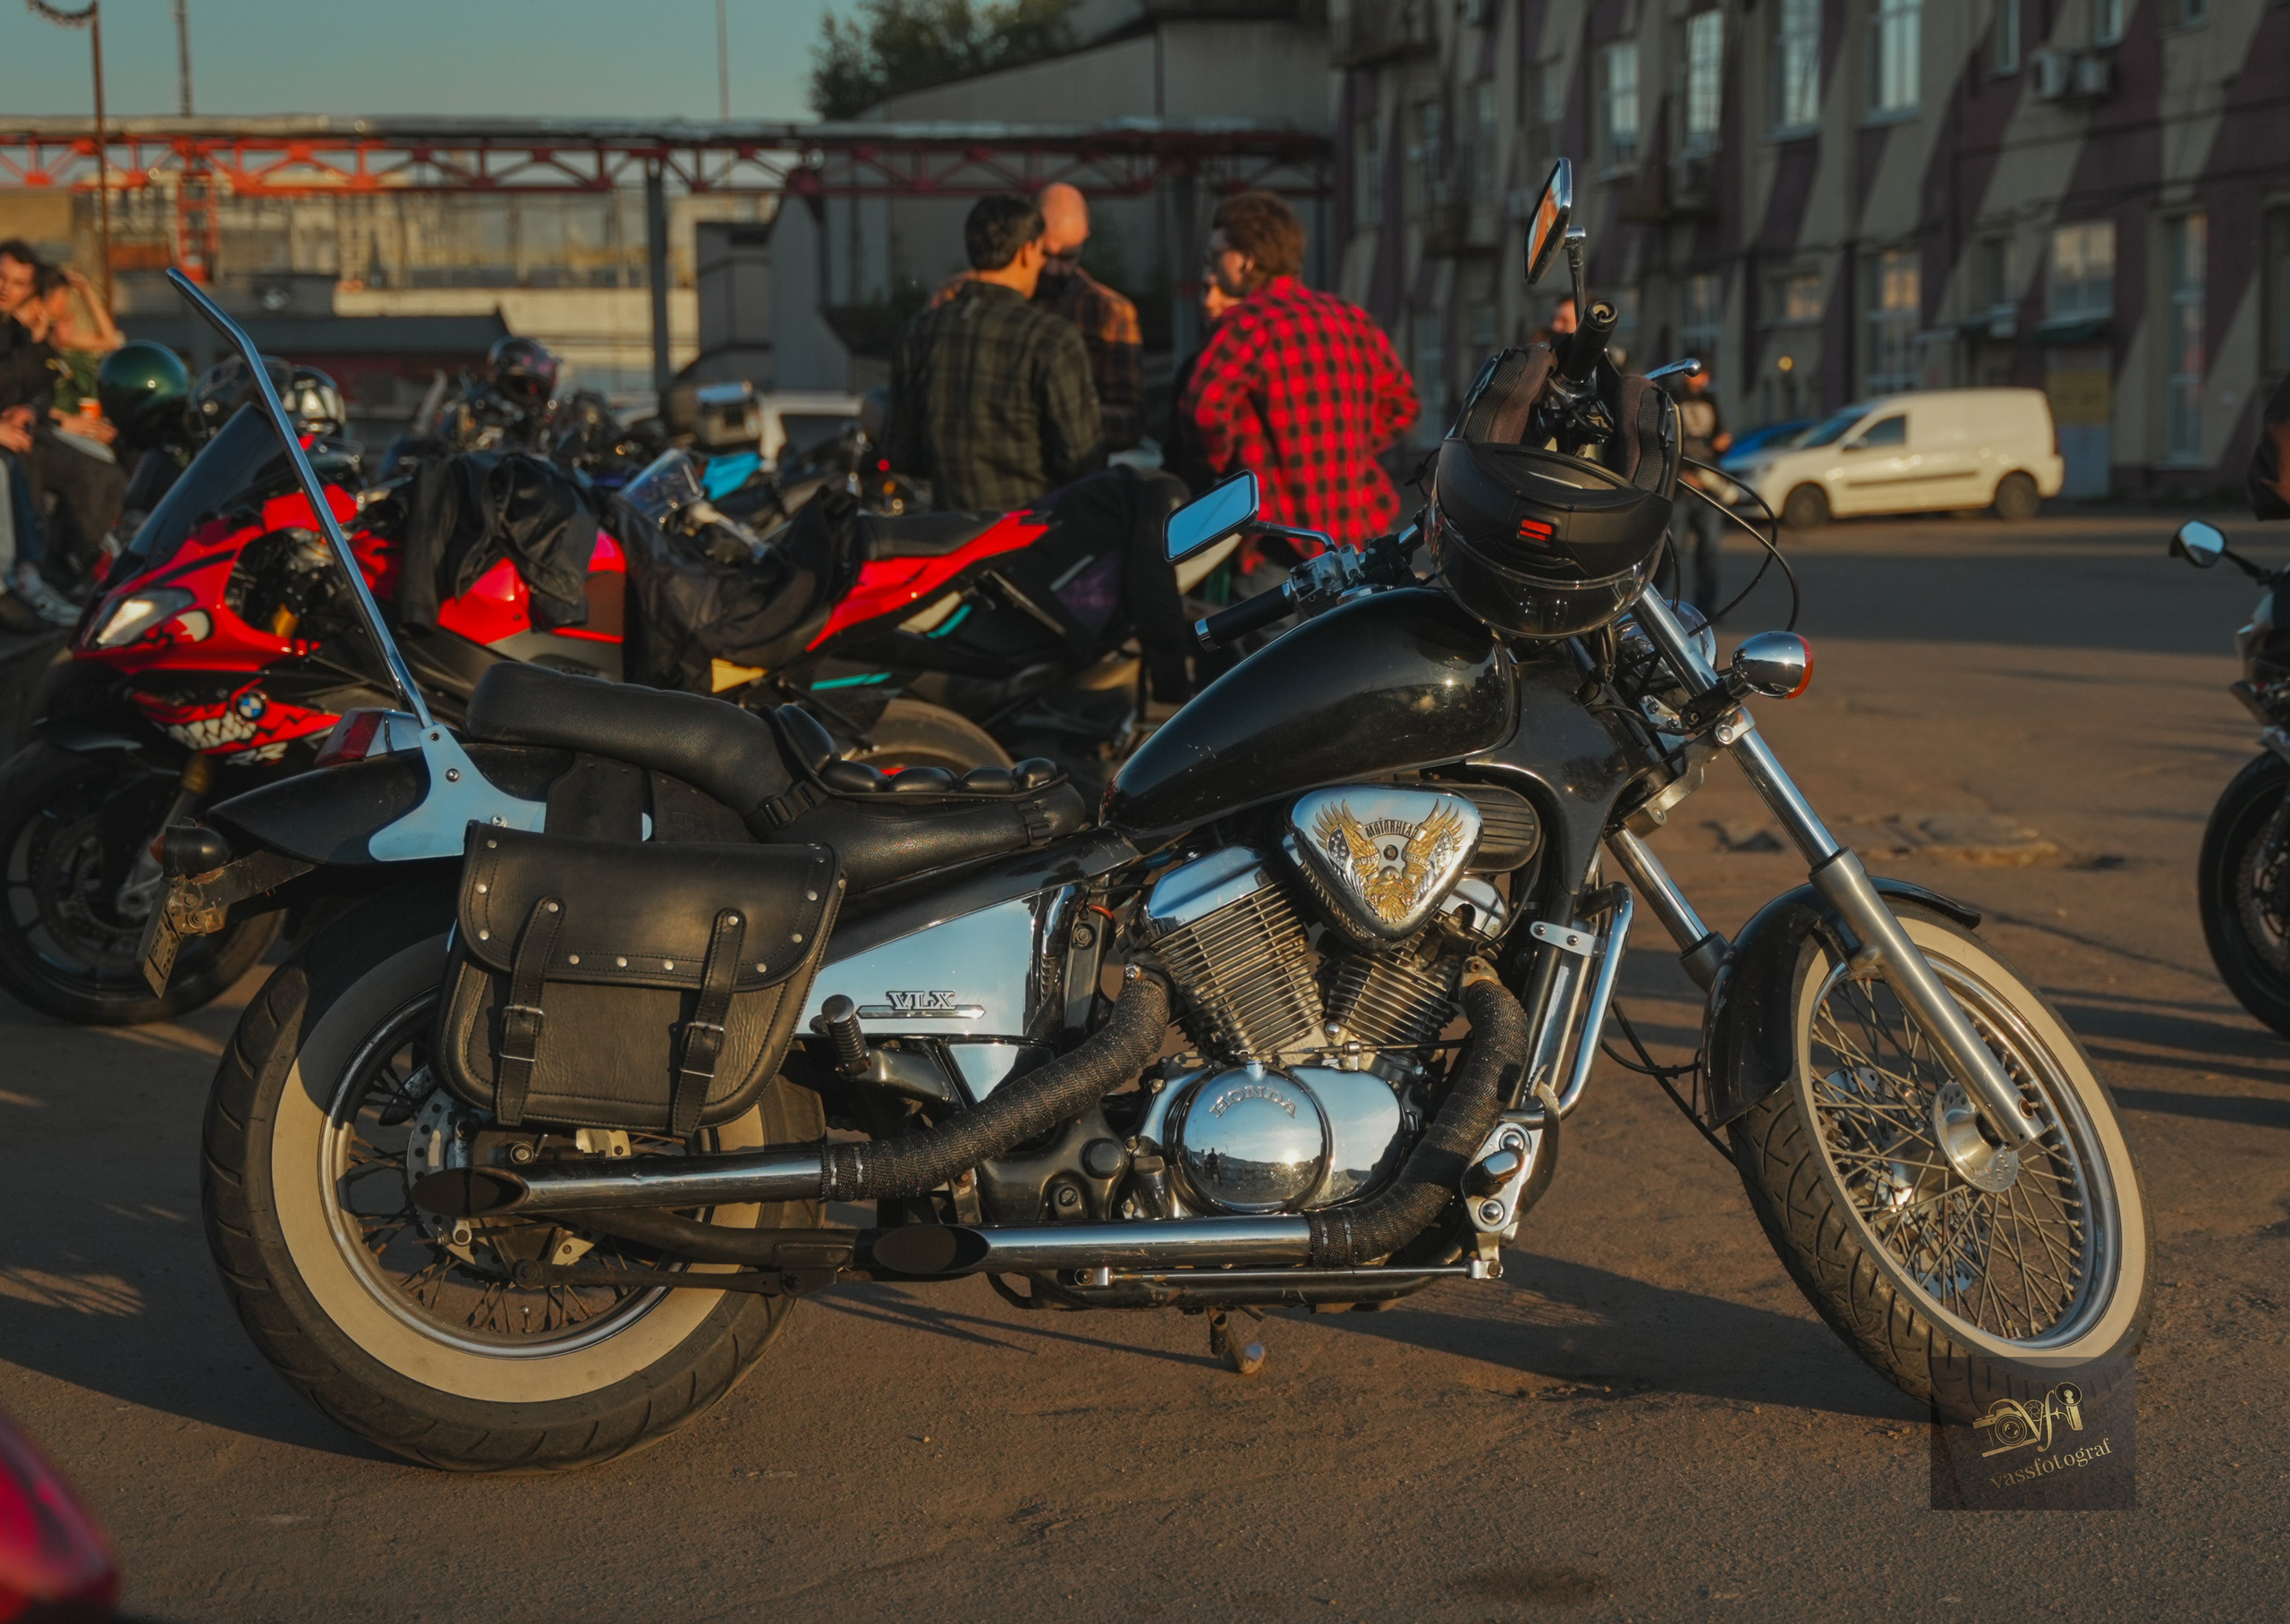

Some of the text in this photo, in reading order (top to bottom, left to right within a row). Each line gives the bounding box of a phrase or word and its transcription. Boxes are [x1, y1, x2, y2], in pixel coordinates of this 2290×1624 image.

[1364, 819, 1420, 839] MOTORHEAD
[886, 990, 955, 1010] VLX
[1209, 1085, 1296, 1119] HONDA
